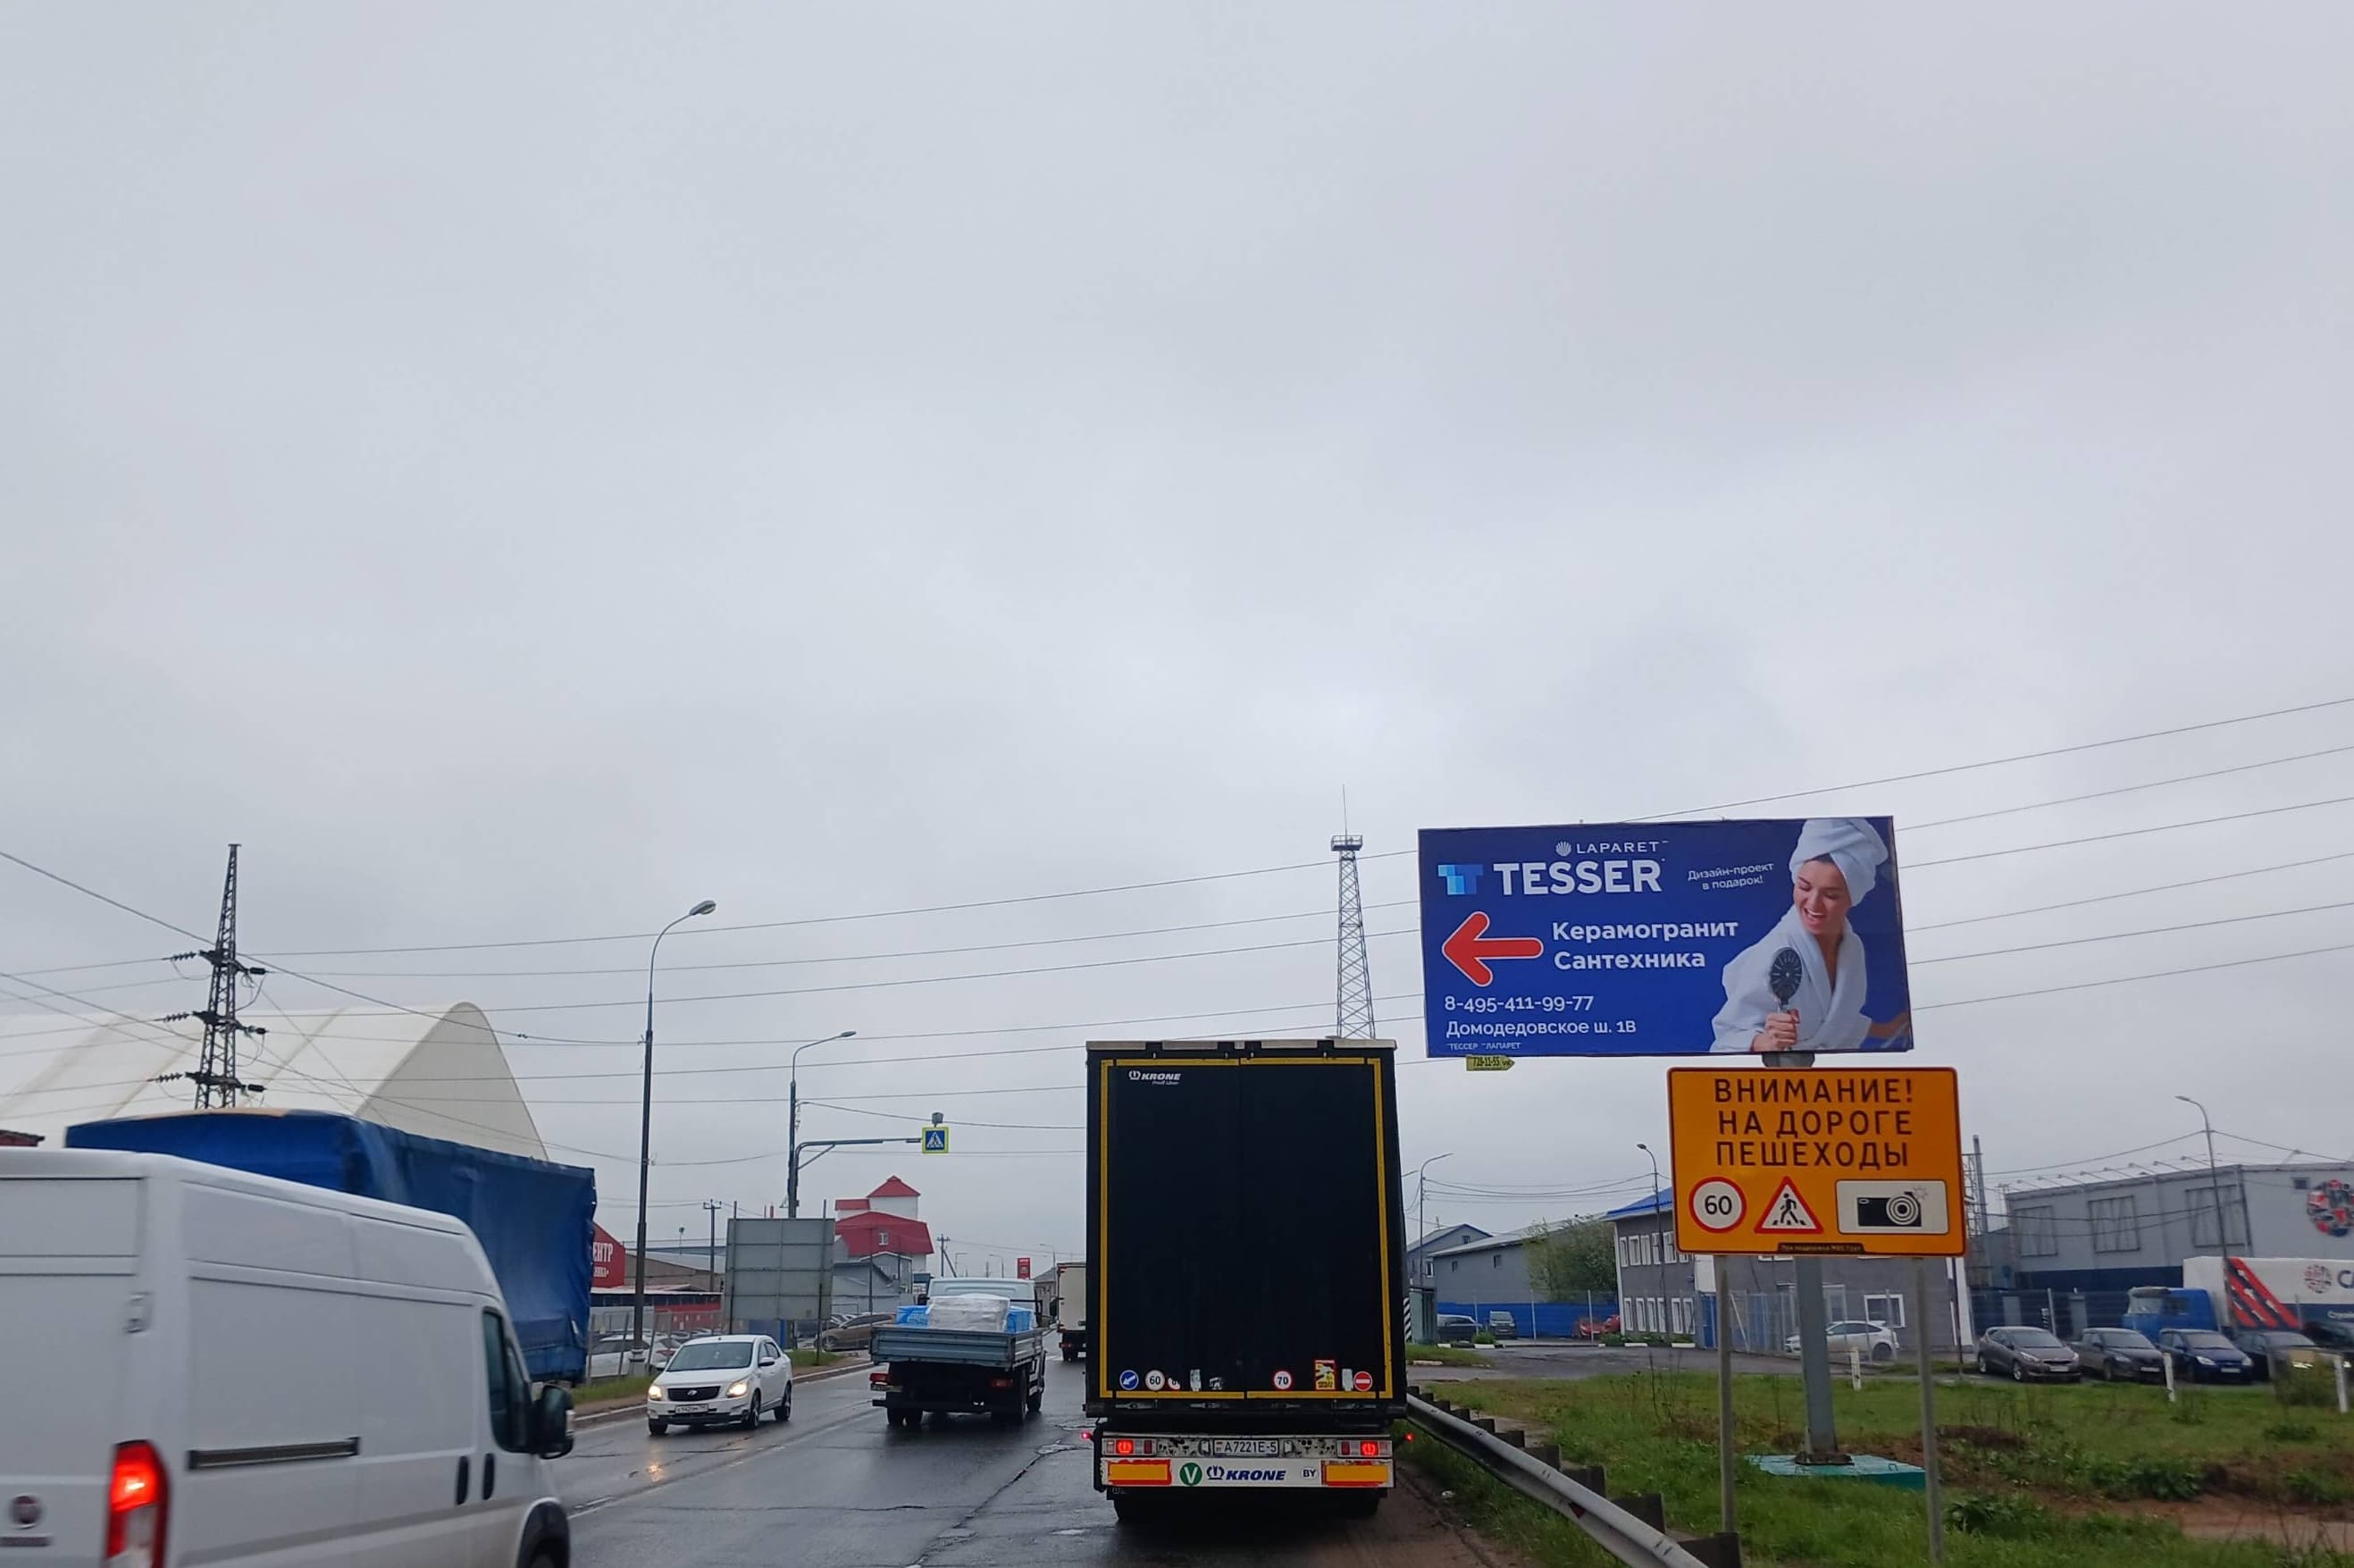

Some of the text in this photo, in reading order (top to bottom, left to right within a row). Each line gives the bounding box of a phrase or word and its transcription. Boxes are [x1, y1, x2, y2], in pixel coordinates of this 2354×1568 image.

[1576, 841, 1660, 854] LAPARET
[1493, 859, 1663, 895] TESSER
[1688, 862, 1775, 881] Дизайн-проект
[1702, 875, 1764, 891] в подарок!
[1552, 919, 1739, 943] Керамогранит
[1554, 951, 1706, 971] Сантехника
[1444, 995, 1595, 1013] 8-495-411-99-77
[1445, 1019, 1637, 1038] Домодедовское ш. 1В
[1714, 1077, 1914, 1104] ВНИМАНИЕ!
[1718, 1110, 1914, 1139] НА ДОРОГЕ
[1716, 1142, 1908, 1171] ПЕШЕХОДЫ
[1705, 1195, 1733, 1216] 60
[1149, 1375, 1161, 1386] 60
[1278, 1376, 1289, 1386] 70
[1225, 1470, 1286, 1480] KRONE
[1303, 1469, 1317, 1478] BY
